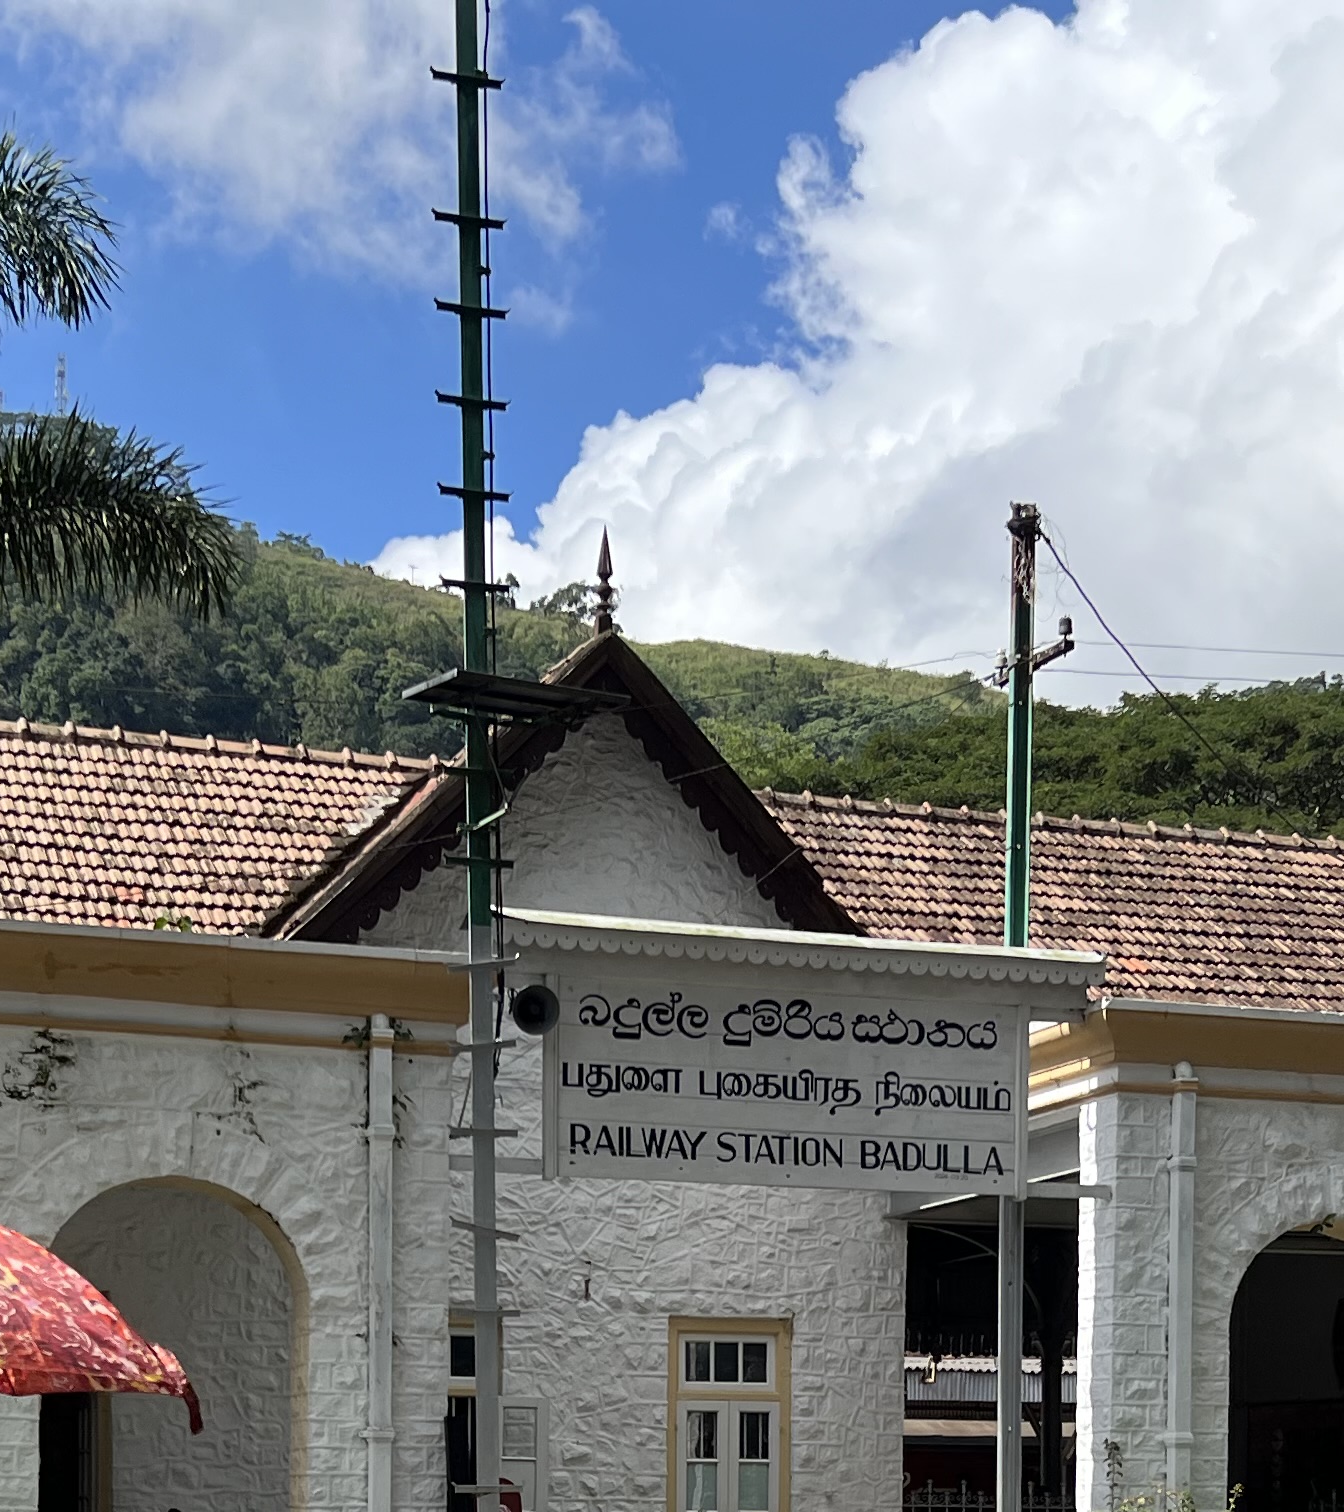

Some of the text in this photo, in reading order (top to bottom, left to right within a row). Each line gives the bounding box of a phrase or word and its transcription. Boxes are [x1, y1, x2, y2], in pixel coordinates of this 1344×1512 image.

[578, 992, 709, 1040] බදුල්ල
[561, 1061, 1011, 1117] பதுளை புகையிரத நிலையம்
[569, 1123, 1005, 1176] RAILWAY STATION BADULLA
